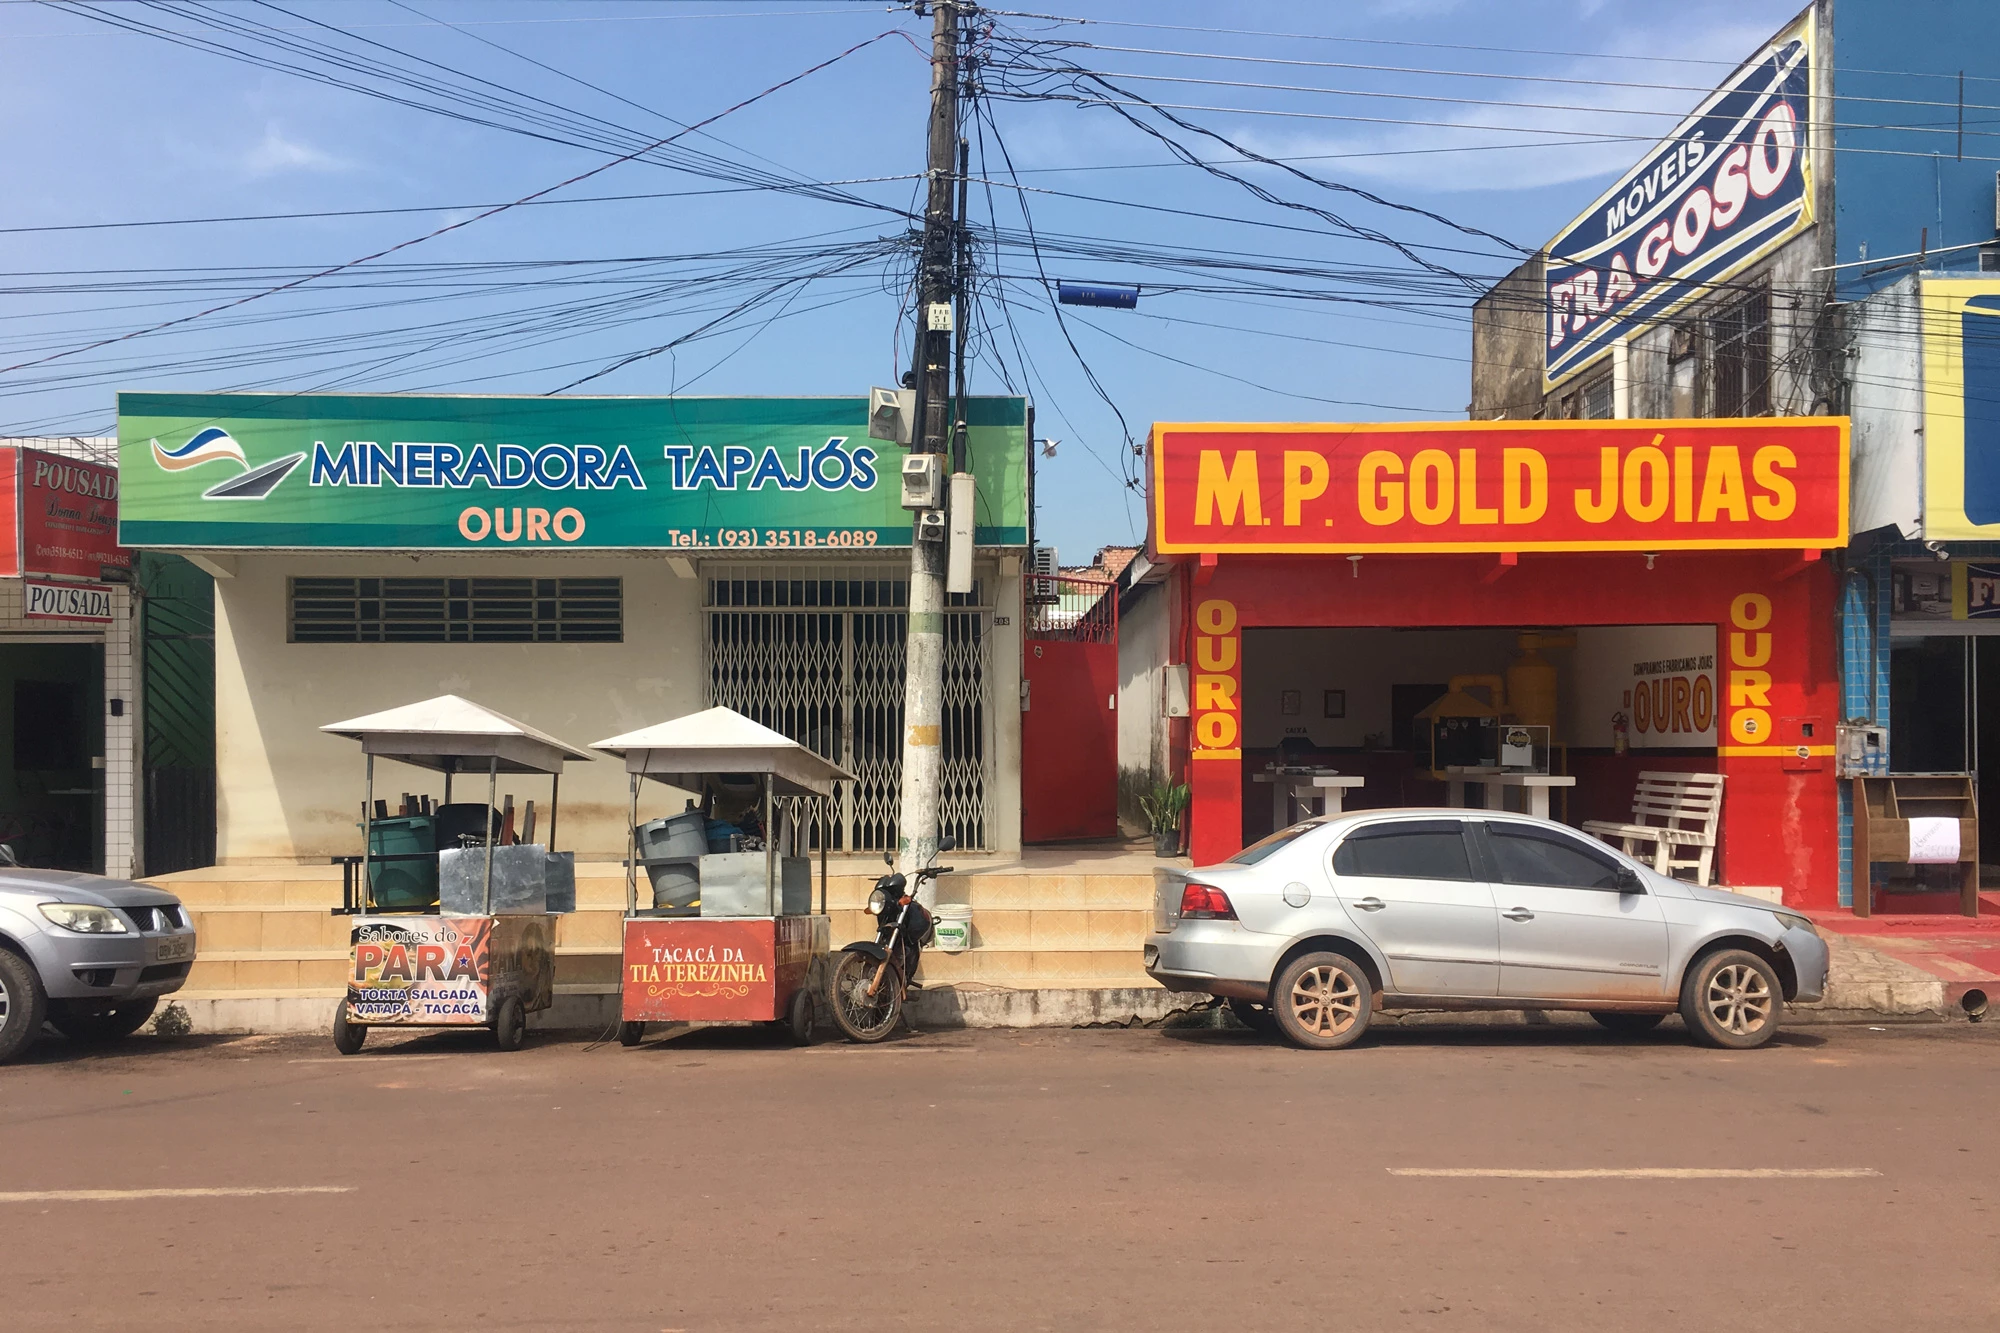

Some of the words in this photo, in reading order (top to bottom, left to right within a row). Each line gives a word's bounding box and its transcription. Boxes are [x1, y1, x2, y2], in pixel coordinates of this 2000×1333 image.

[1606, 130, 1706, 237] MÓVEIS
[1550, 101, 1796, 349] FRAGOSO
[32, 459, 119, 501] POUSAD
[309, 441, 647, 490] MINERADORA
[664, 437, 879, 491] TAPAJÓS
[1194, 449, 1333, 527] M.P.
[1357, 447, 1548, 526] GOLD
[1574, 433, 1798, 524] JÓIAS
[458, 506, 586, 541] OURO
[668, 529, 710, 546] Tel.:
[717, 528, 758, 547] (93)
[765, 530, 878, 546] 3518-6089
[29, 587, 111, 616] POUSADA
[1196, 599, 1237, 748] OURO
[1730, 592, 1772, 744] OURO
[1634, 674, 1713, 734] OURO
[359, 926, 429, 942] Sabores
[434, 927, 457, 942] do
[652, 945, 716, 963] TACACÁ
[722, 948, 745, 963] DA
[355, 936, 481, 982] PARÁ
[630, 964, 661, 983] TIA
[663, 963, 767, 983] TEREZINHA
[356, 1002, 412, 1014] VATAPÁ
[424, 1002, 481, 1014] TACACÁ
[359, 989, 407, 1001] TORTA
[411, 989, 478, 1000] SALGADA
